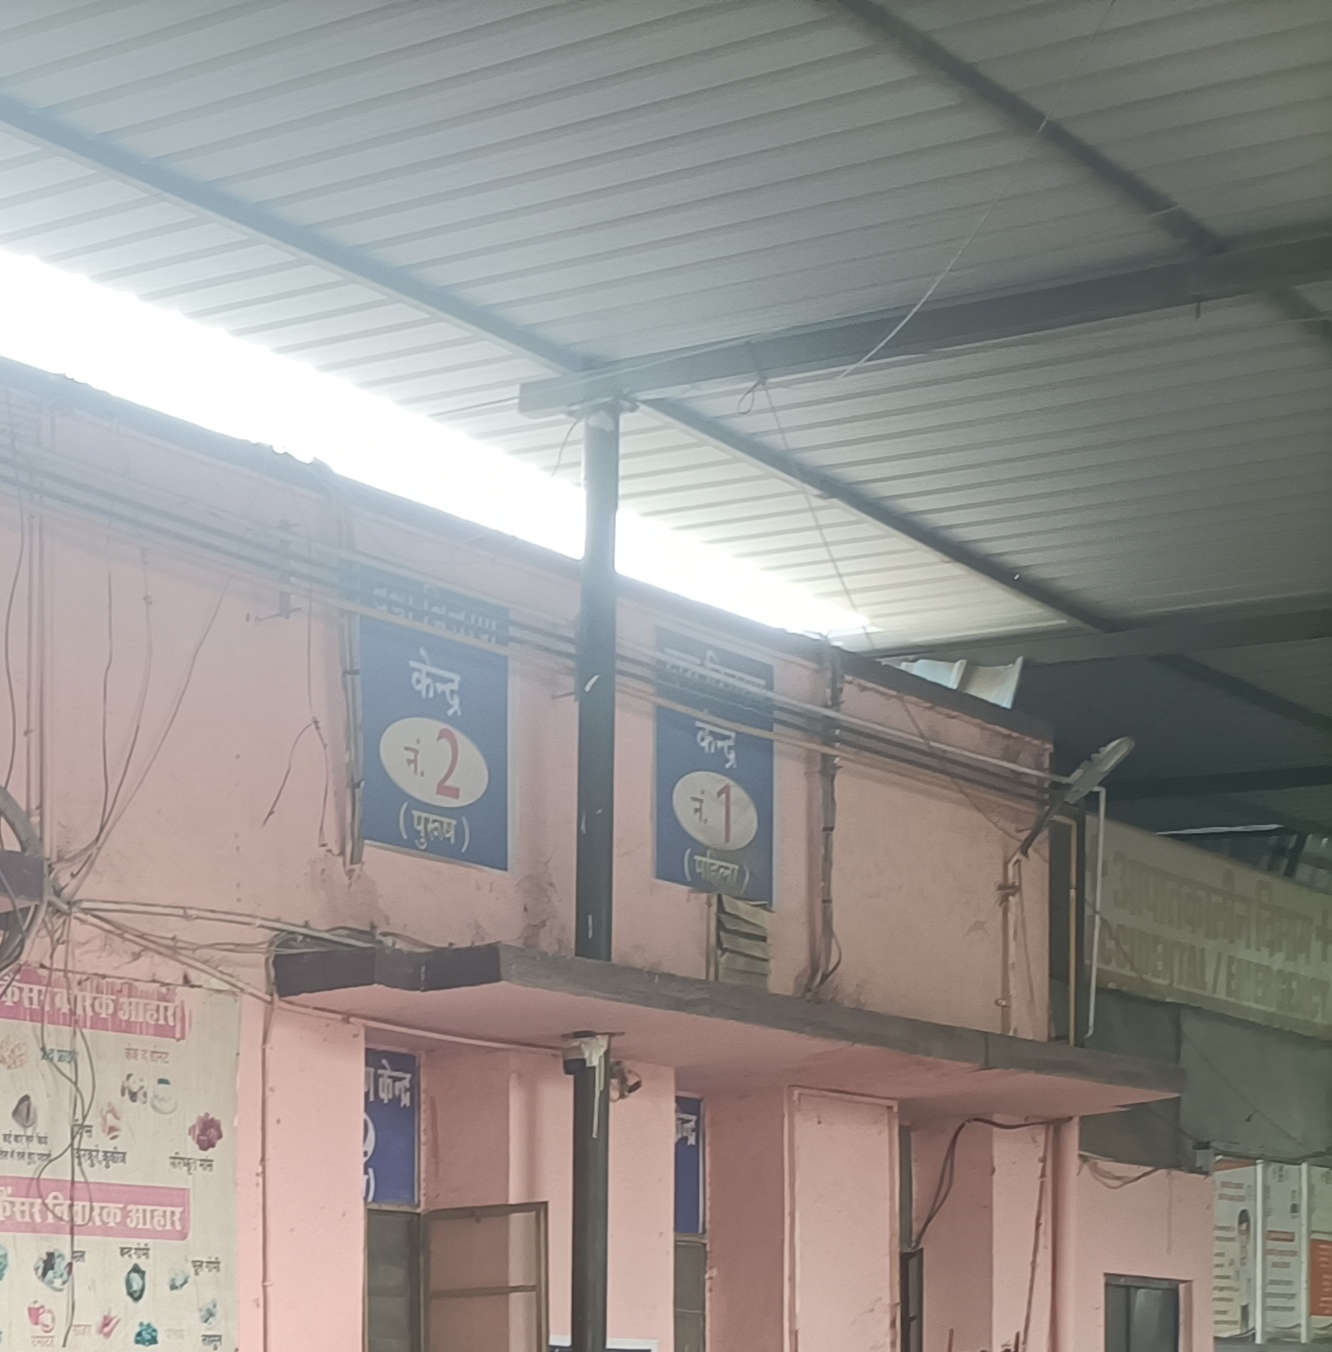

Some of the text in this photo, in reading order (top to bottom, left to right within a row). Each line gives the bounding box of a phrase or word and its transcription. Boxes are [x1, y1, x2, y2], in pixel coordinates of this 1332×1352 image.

[409, 648, 461, 716] केन्द्र
[436, 727, 460, 800] 2
[717, 783, 731, 844] 1
[119, 994, 177, 1027] आहार
[126, 1204, 185, 1232] आहार
